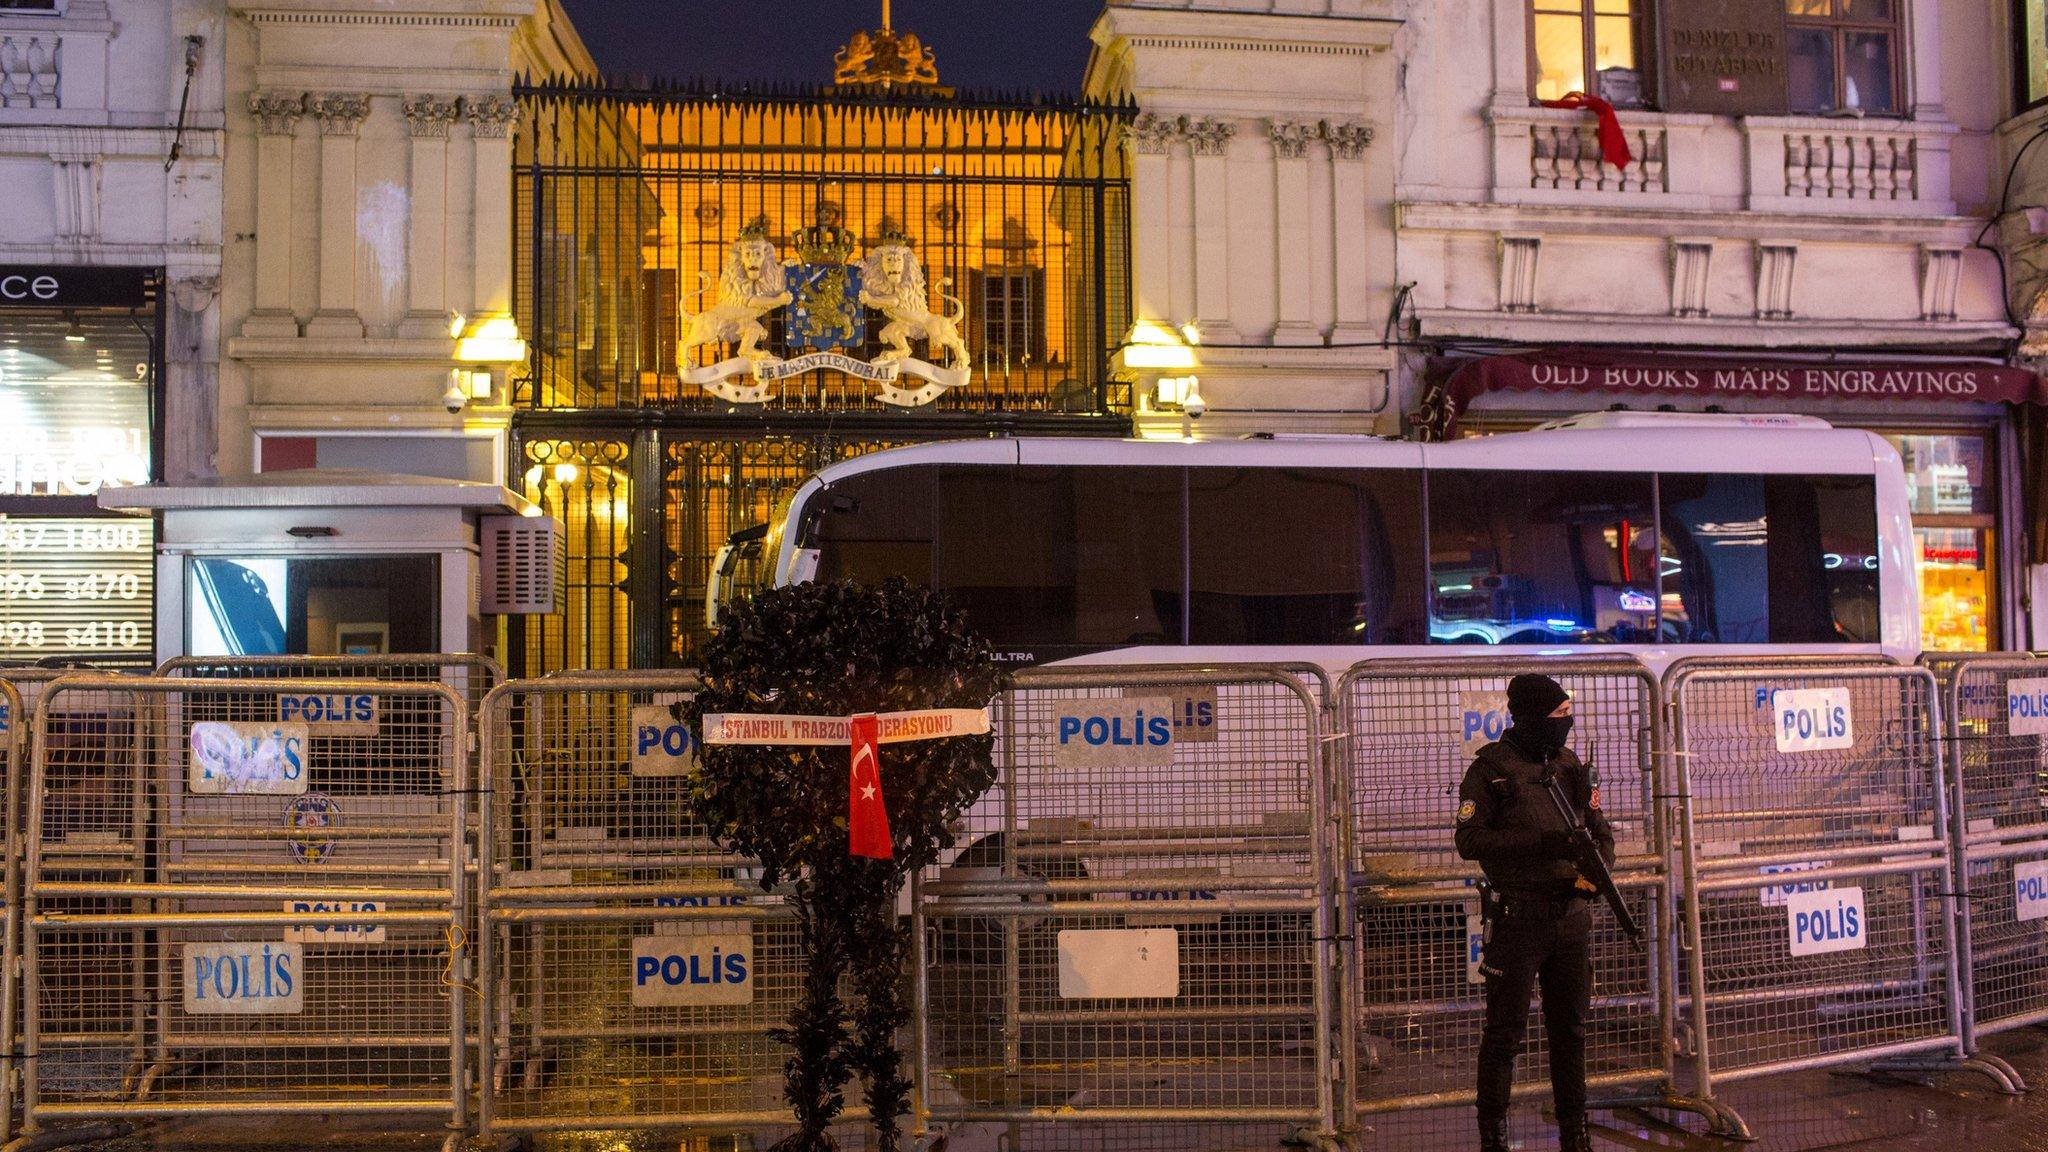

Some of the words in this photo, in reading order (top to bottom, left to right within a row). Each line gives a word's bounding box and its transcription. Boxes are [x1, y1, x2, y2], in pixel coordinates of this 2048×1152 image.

[759, 367, 774, 379] JE
[1532, 365, 1590, 384] OLD
[1604, 368, 1699, 388] BOOKS
[1805, 369, 1978, 394] ENGRAVINGS
[64, 524, 140, 550] 1500
[989, 652, 1035, 661] ULTRA
[877, 715, 952, 738] DERASYONU
[1060, 710, 1170, 746] POLİS
[1783, 699, 1846, 740] POLİS
[1796, 900, 1859, 944] POLİS
[194, 943, 293, 999] POLİS
[637, 946, 747, 986] POLİS
